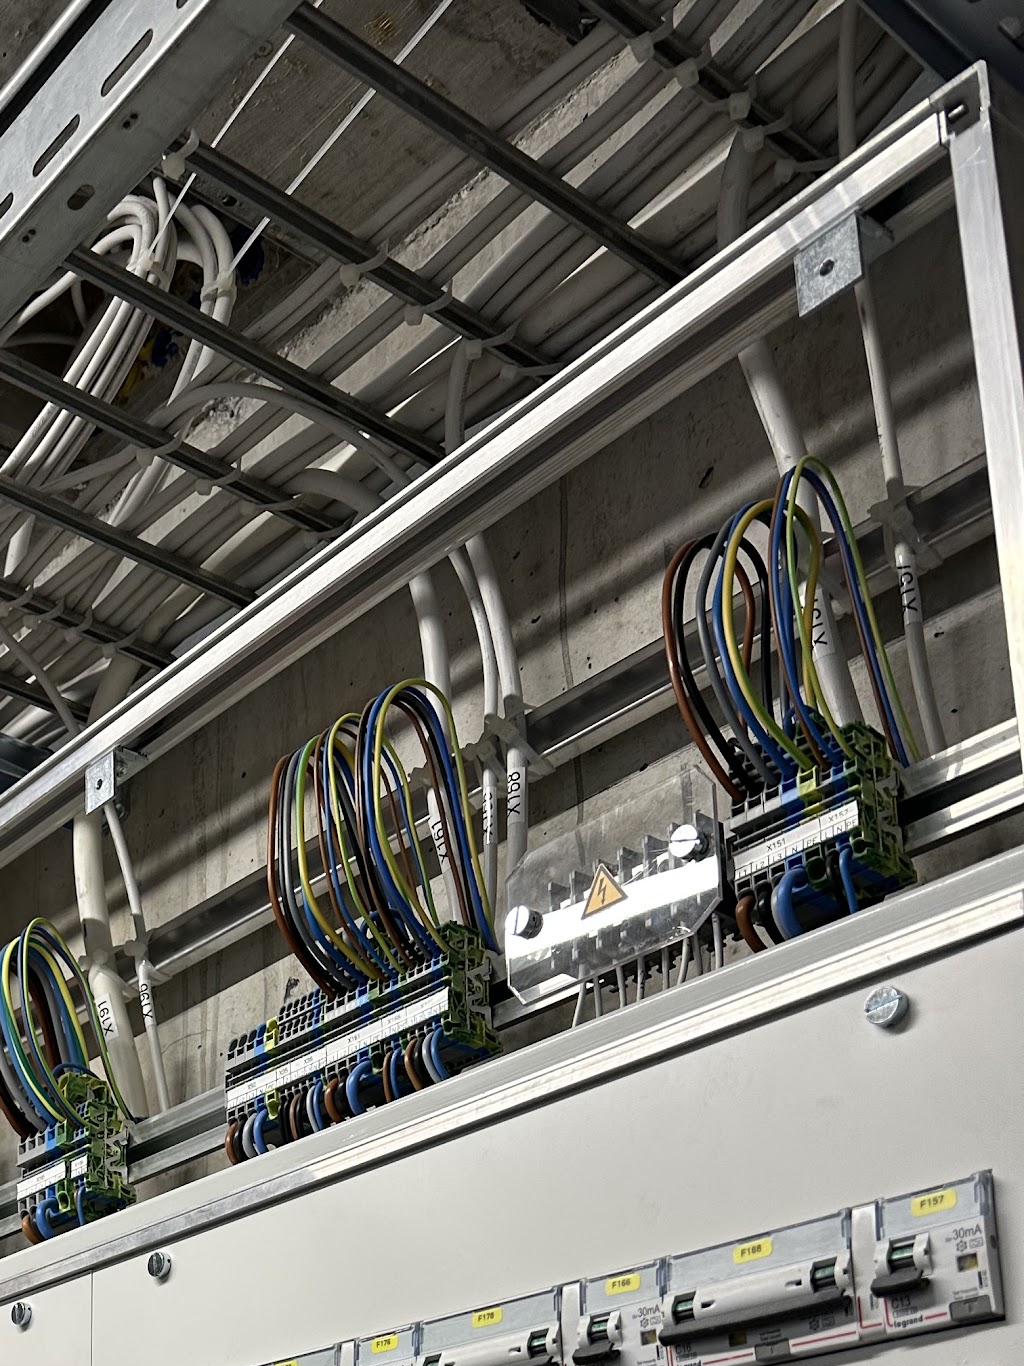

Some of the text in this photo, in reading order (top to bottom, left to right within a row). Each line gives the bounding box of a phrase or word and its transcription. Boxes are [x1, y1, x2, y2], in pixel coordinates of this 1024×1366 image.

[828, 808, 849, 823] X157
[766, 837, 786, 852] X151
[97, 1000, 114, 1036] X191
[919, 1194, 945, 1209] F157
[611, 1278, 631, 1290] F166
[893, 1314, 924, 1328] legrand
